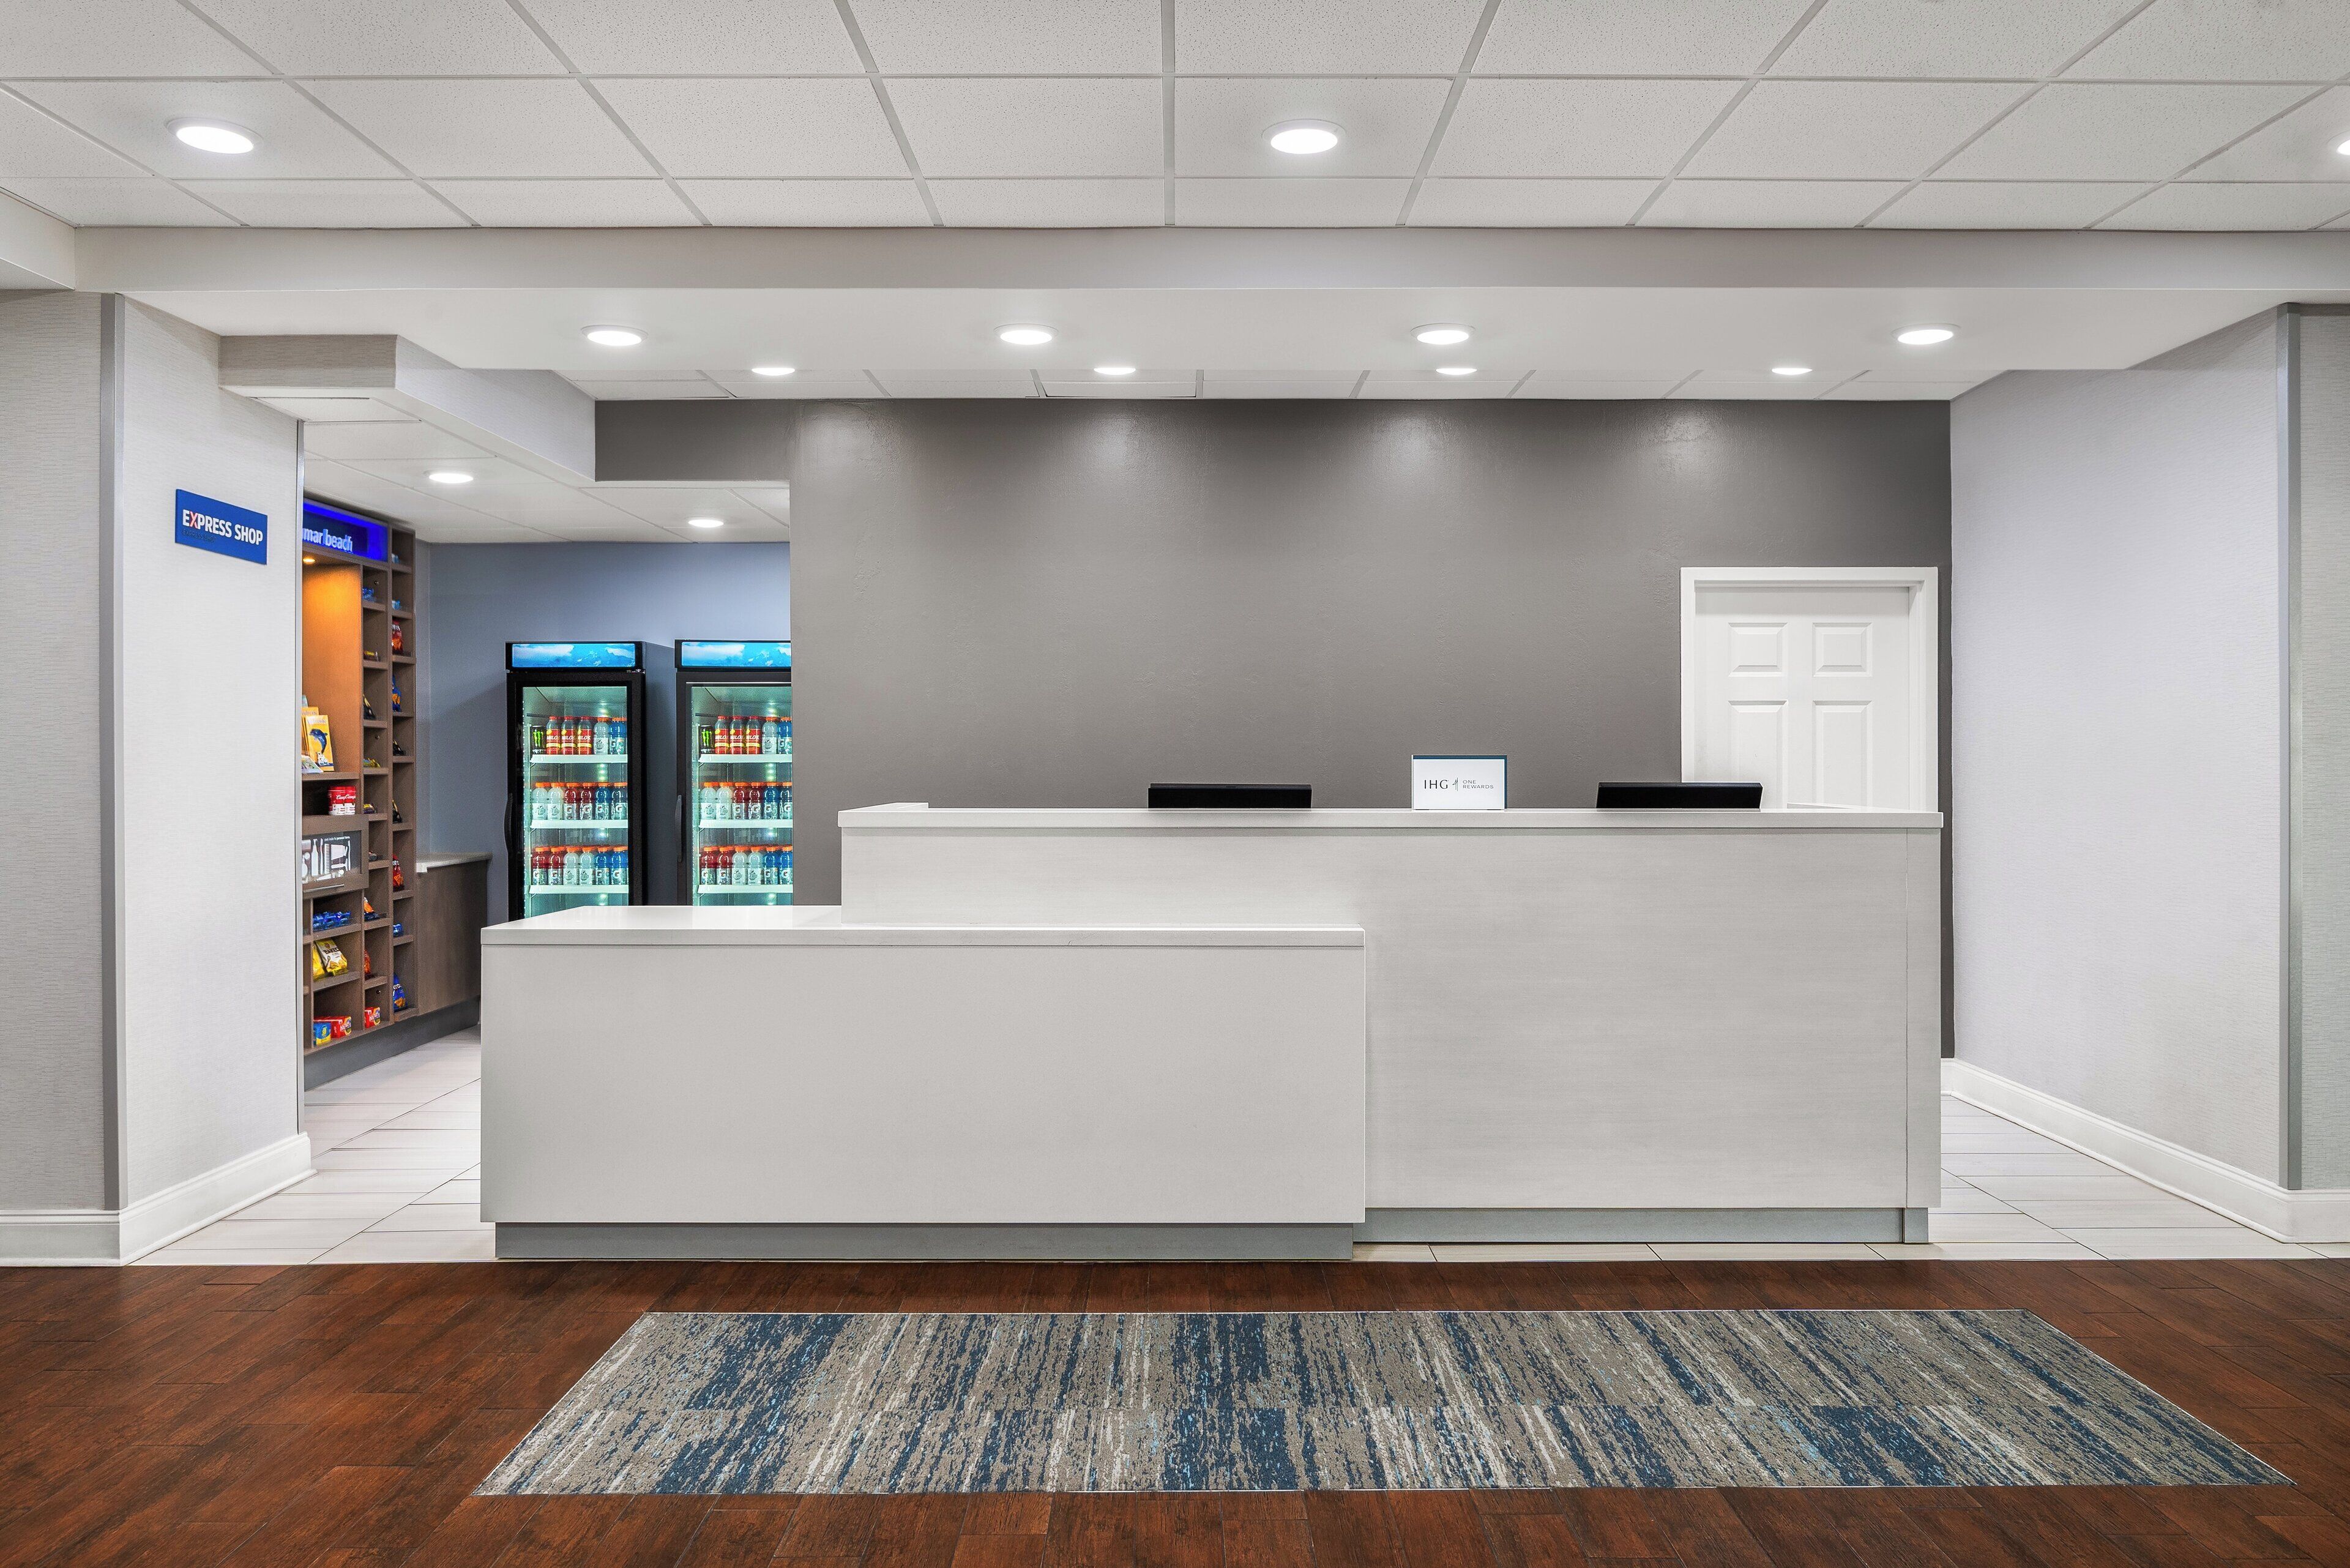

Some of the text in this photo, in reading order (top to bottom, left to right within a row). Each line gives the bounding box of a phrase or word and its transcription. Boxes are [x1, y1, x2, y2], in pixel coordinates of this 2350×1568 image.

[182, 509, 263, 545] EXPRESS SHOP
[323, 529, 353, 552] beach
[1424, 779, 1448, 790] IHG
